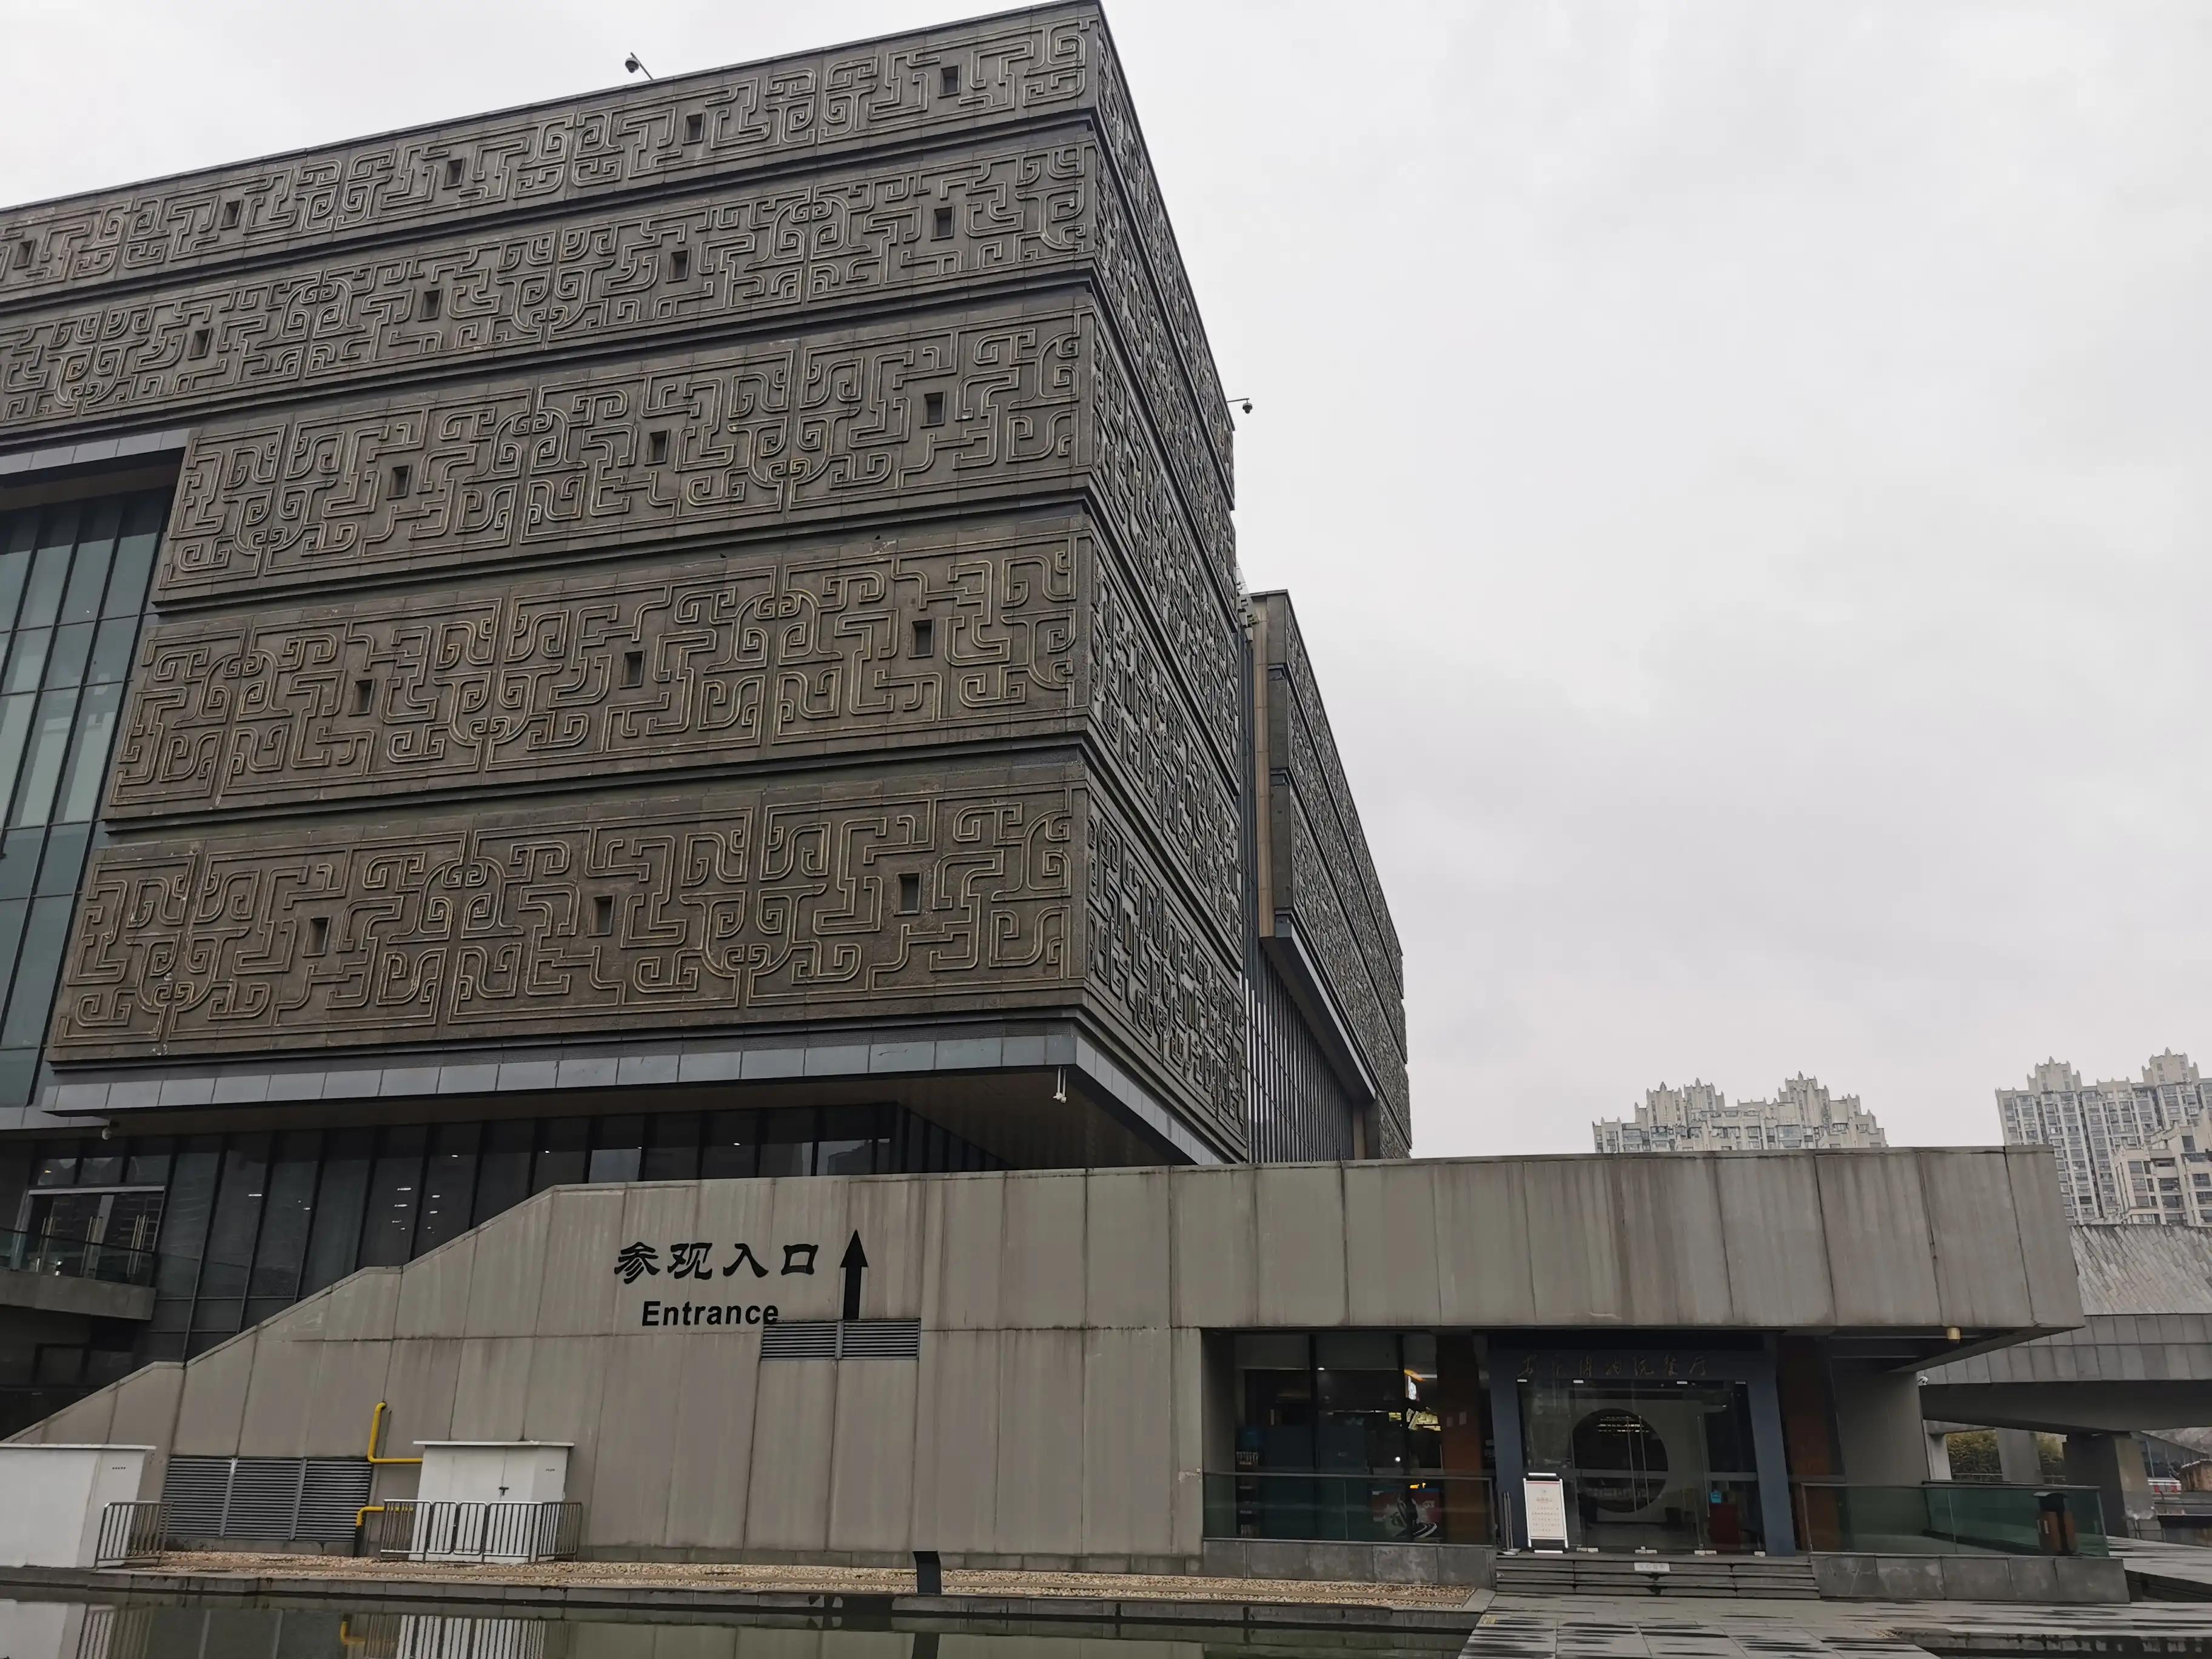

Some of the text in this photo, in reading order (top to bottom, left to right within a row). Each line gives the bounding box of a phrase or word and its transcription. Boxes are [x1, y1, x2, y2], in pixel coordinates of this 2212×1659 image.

[614, 1242, 819, 1284] 参观入口
[642, 1301, 779, 1326] Entrance
